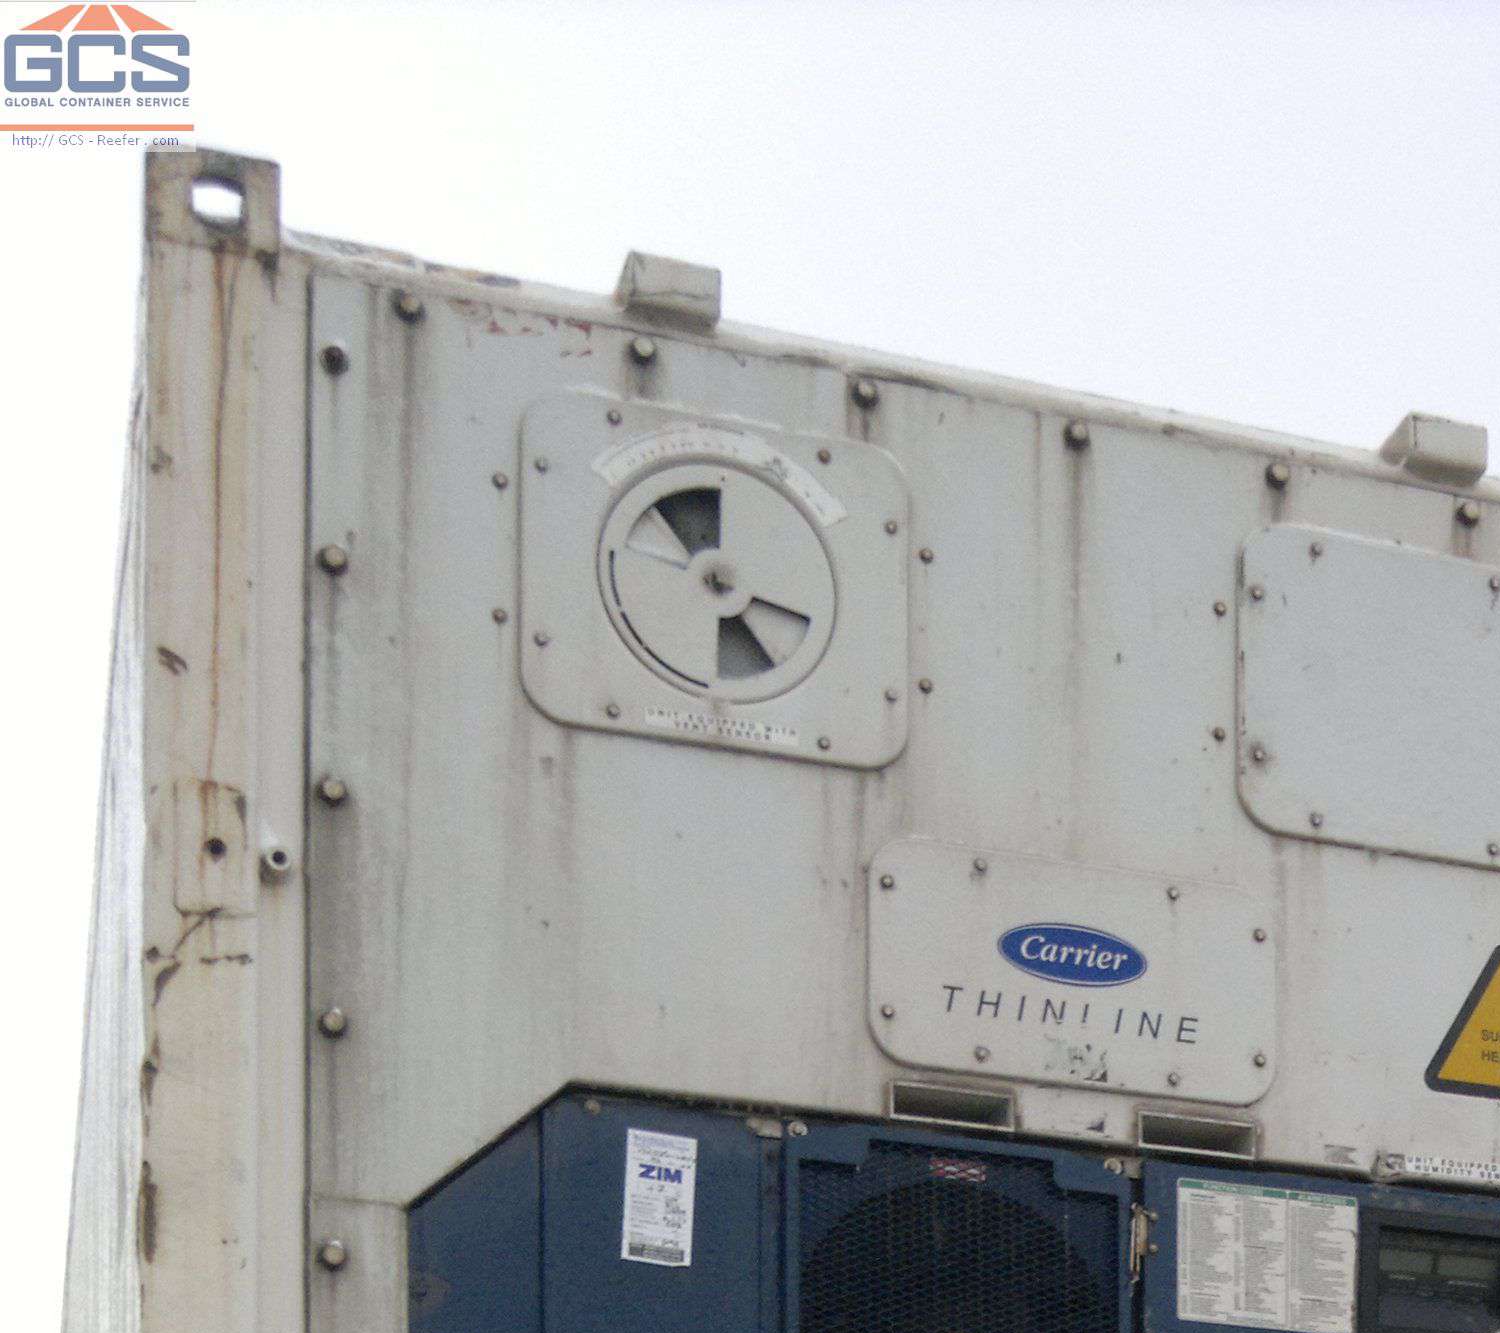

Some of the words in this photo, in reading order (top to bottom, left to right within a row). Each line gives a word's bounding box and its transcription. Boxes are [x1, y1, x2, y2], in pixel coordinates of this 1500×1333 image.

[1020, 935, 1129, 971] Carrier
[639, 1163, 683, 1184] ZIM
[1414, 1163, 1472, 1177] HUMIDITY
[1441, 1158, 1498, 1173] EQUIPPED
